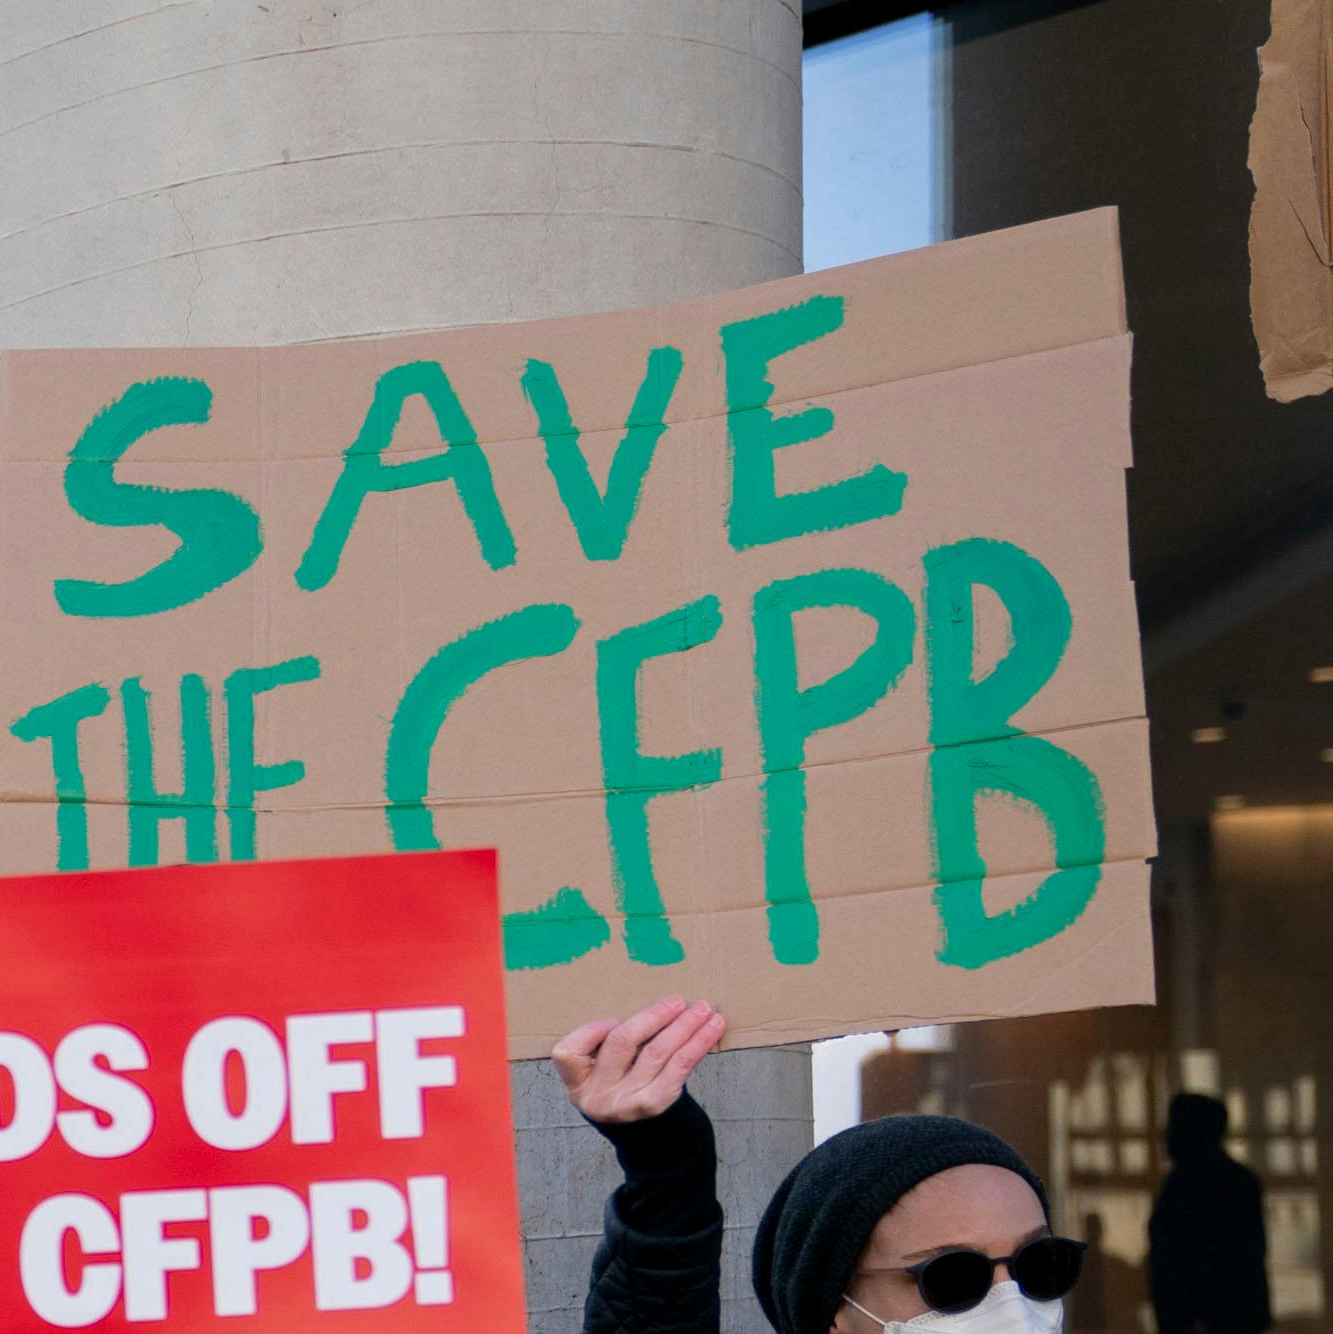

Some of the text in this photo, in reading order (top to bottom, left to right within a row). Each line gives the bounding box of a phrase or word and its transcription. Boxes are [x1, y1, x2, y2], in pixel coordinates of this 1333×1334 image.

[53, 293, 909, 619] SAVE
[381, 536, 1109, 973] CFPB
[181, 1005, 466, 1151] OFF
[19, 1175, 454, 1327] CFPB!
